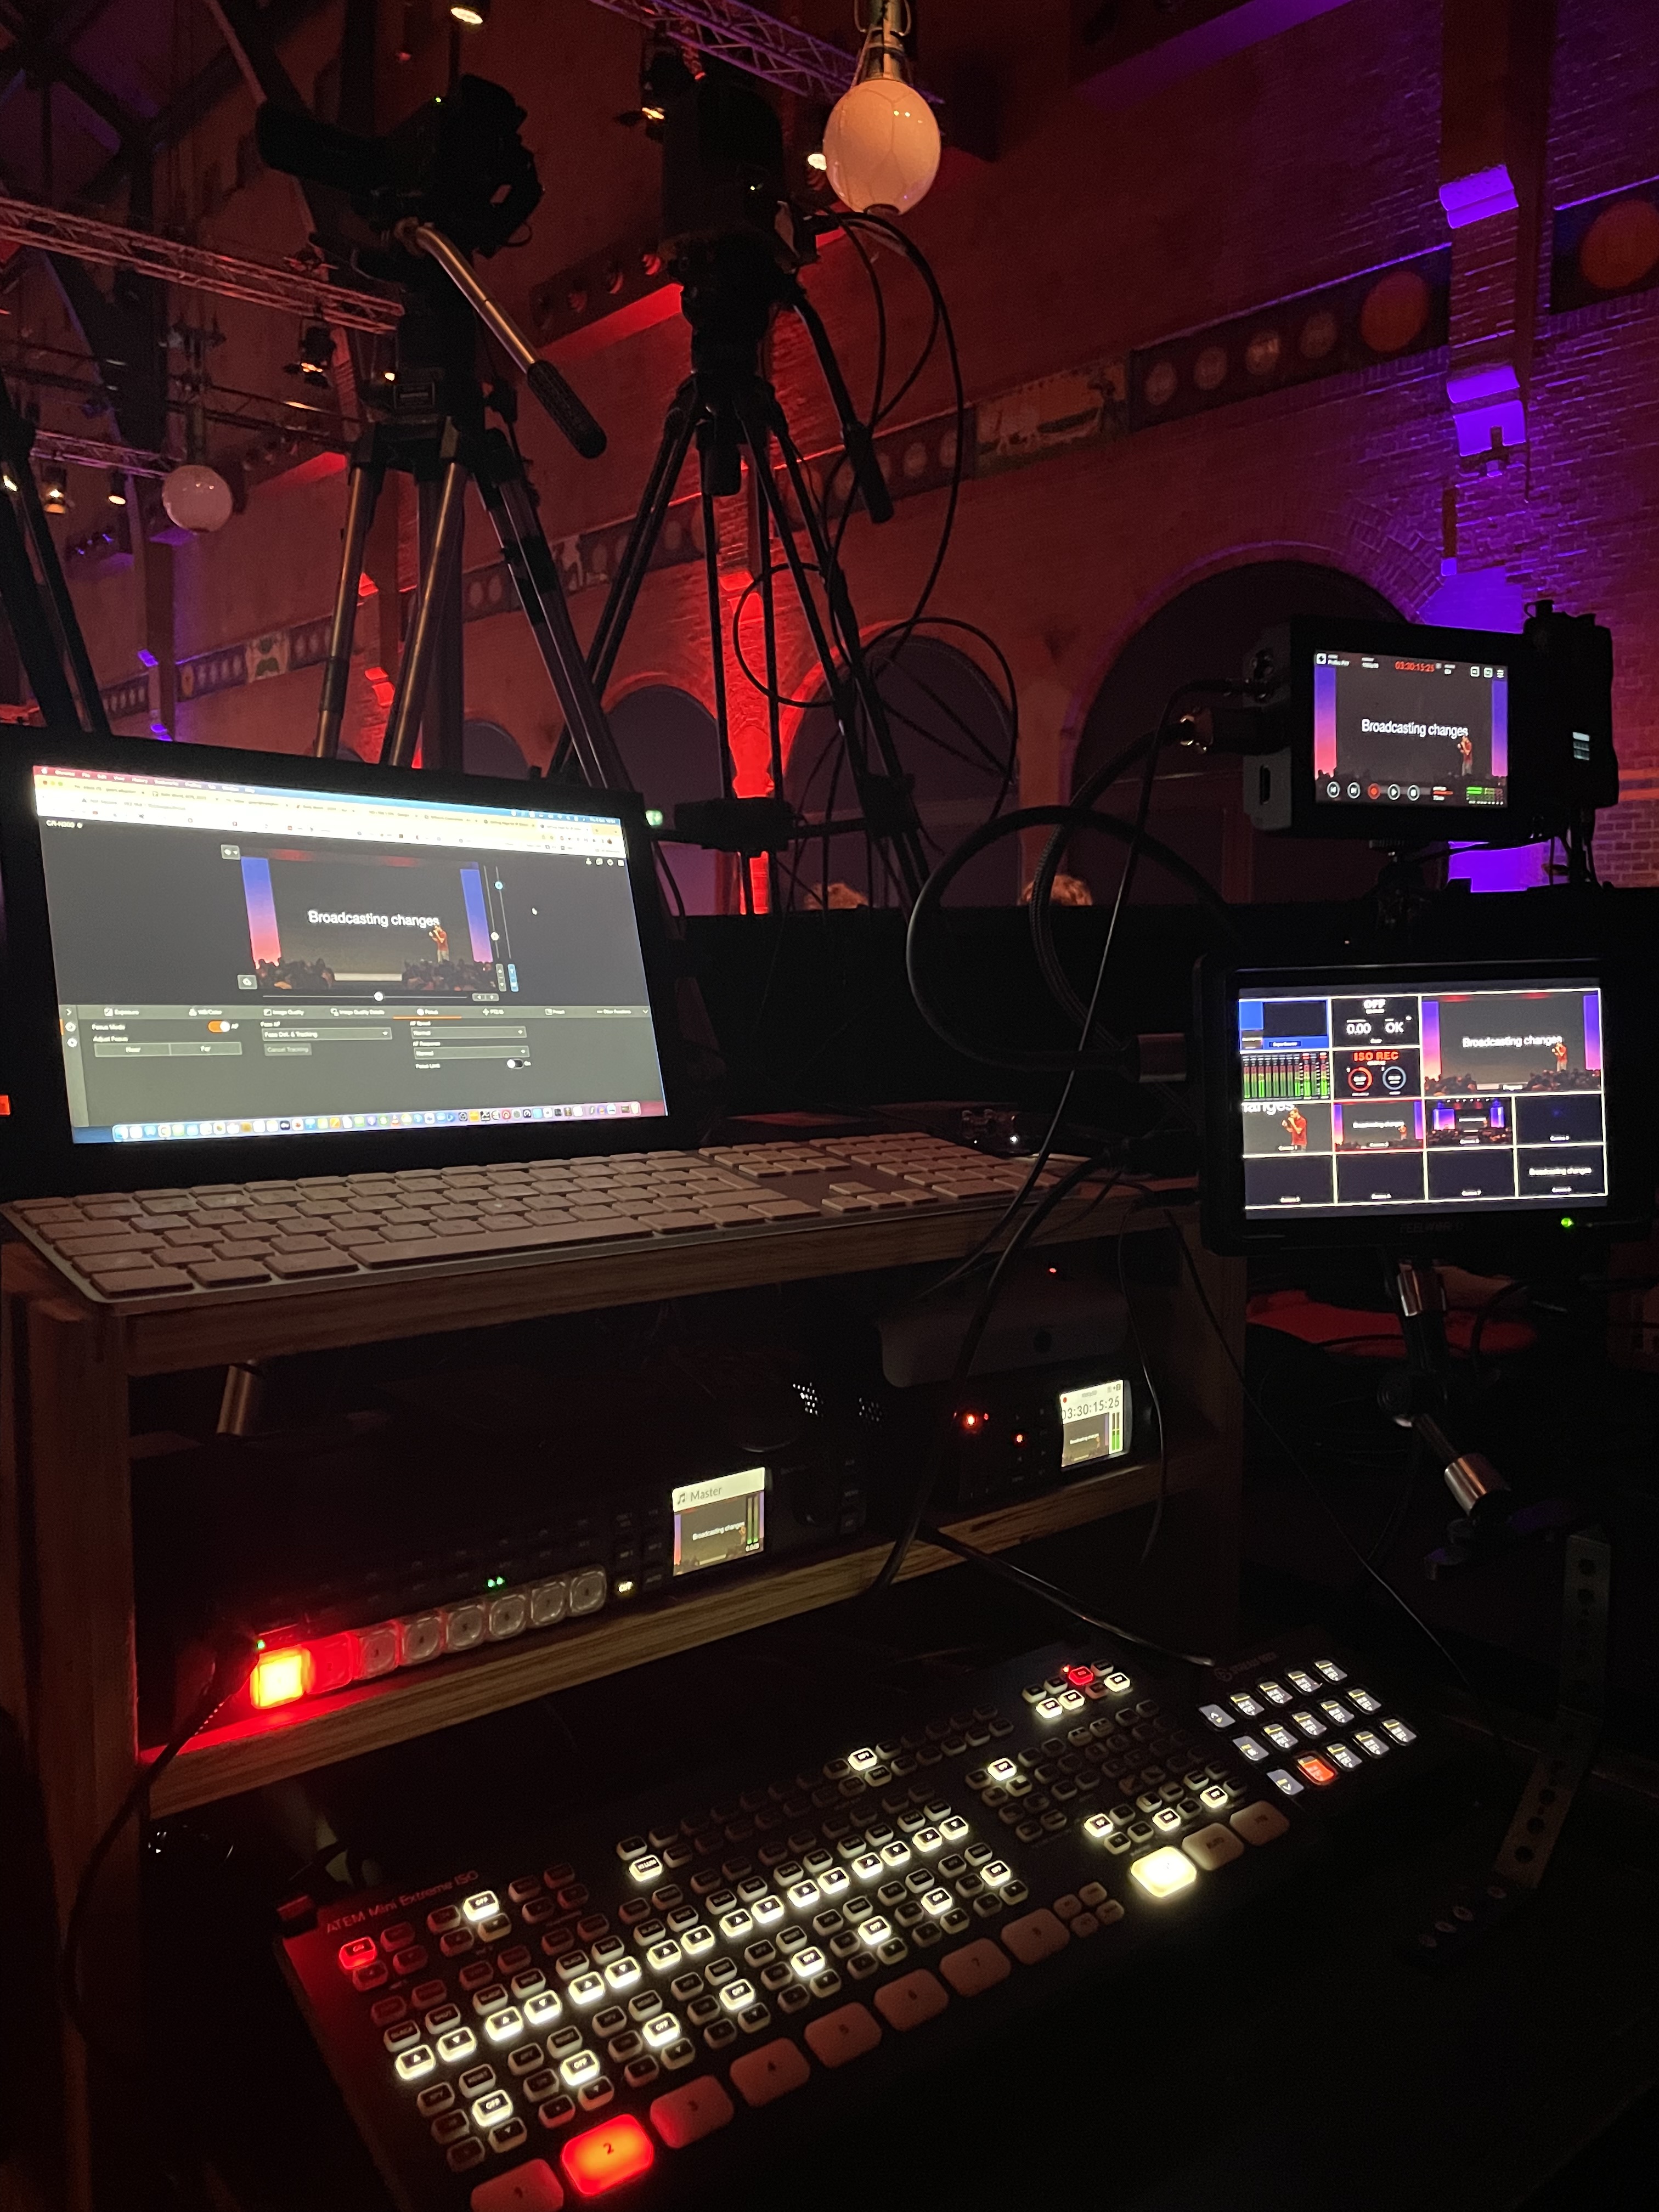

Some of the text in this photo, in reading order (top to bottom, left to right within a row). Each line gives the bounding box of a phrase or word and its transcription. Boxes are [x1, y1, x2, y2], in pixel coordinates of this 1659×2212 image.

[1361, 719, 1469, 740] Broadcasting changes
[308, 910, 440, 929] Broadcasting changes
[1363, 999, 1386, 1009] OFF
[1346, 1023, 1372, 1035] 0.00
[1385, 1022, 1404, 1033] OK
[1462, 1035, 1562, 1048] Broadcasting changes
[1353, 1051, 1399, 1062] ISO REC
[690, 1486, 722, 1502] Master
[326, 1870, 479, 1934] ATEM Mini Extreme ISO
[656, 2020, 669, 2031] OFF
[574, 2058, 588, 2069] OFF
[486, 2098, 500, 2109] OFF
